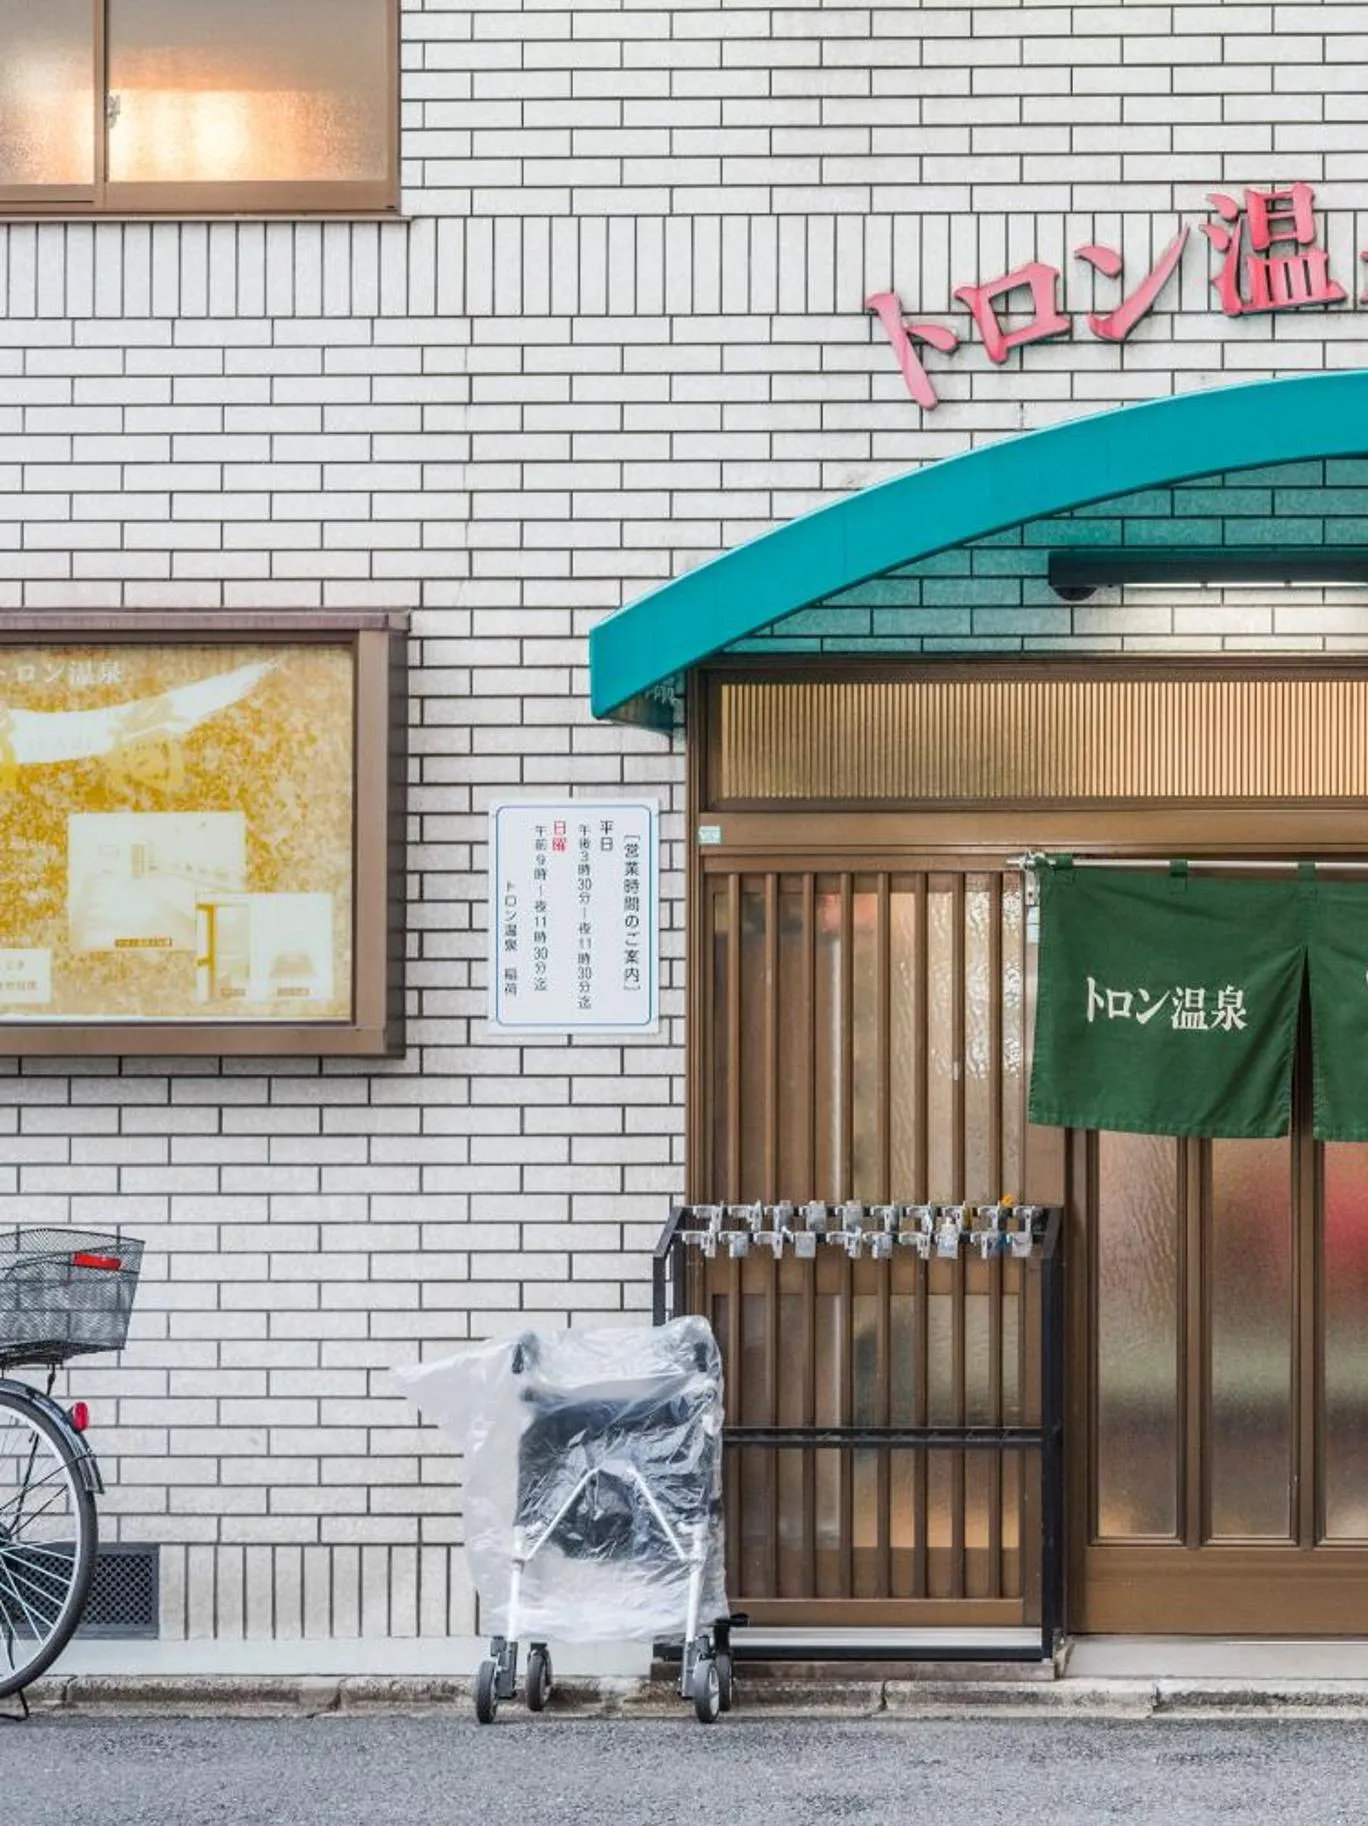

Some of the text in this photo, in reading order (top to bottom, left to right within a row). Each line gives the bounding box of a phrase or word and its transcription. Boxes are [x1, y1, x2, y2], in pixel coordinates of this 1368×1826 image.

[552, 820, 567, 852] 日曜
[600, 820, 614, 852] 平日
[504, 881, 517, 951] トロン温泉
[1086, 976, 1249, 1032] トロン温泉
